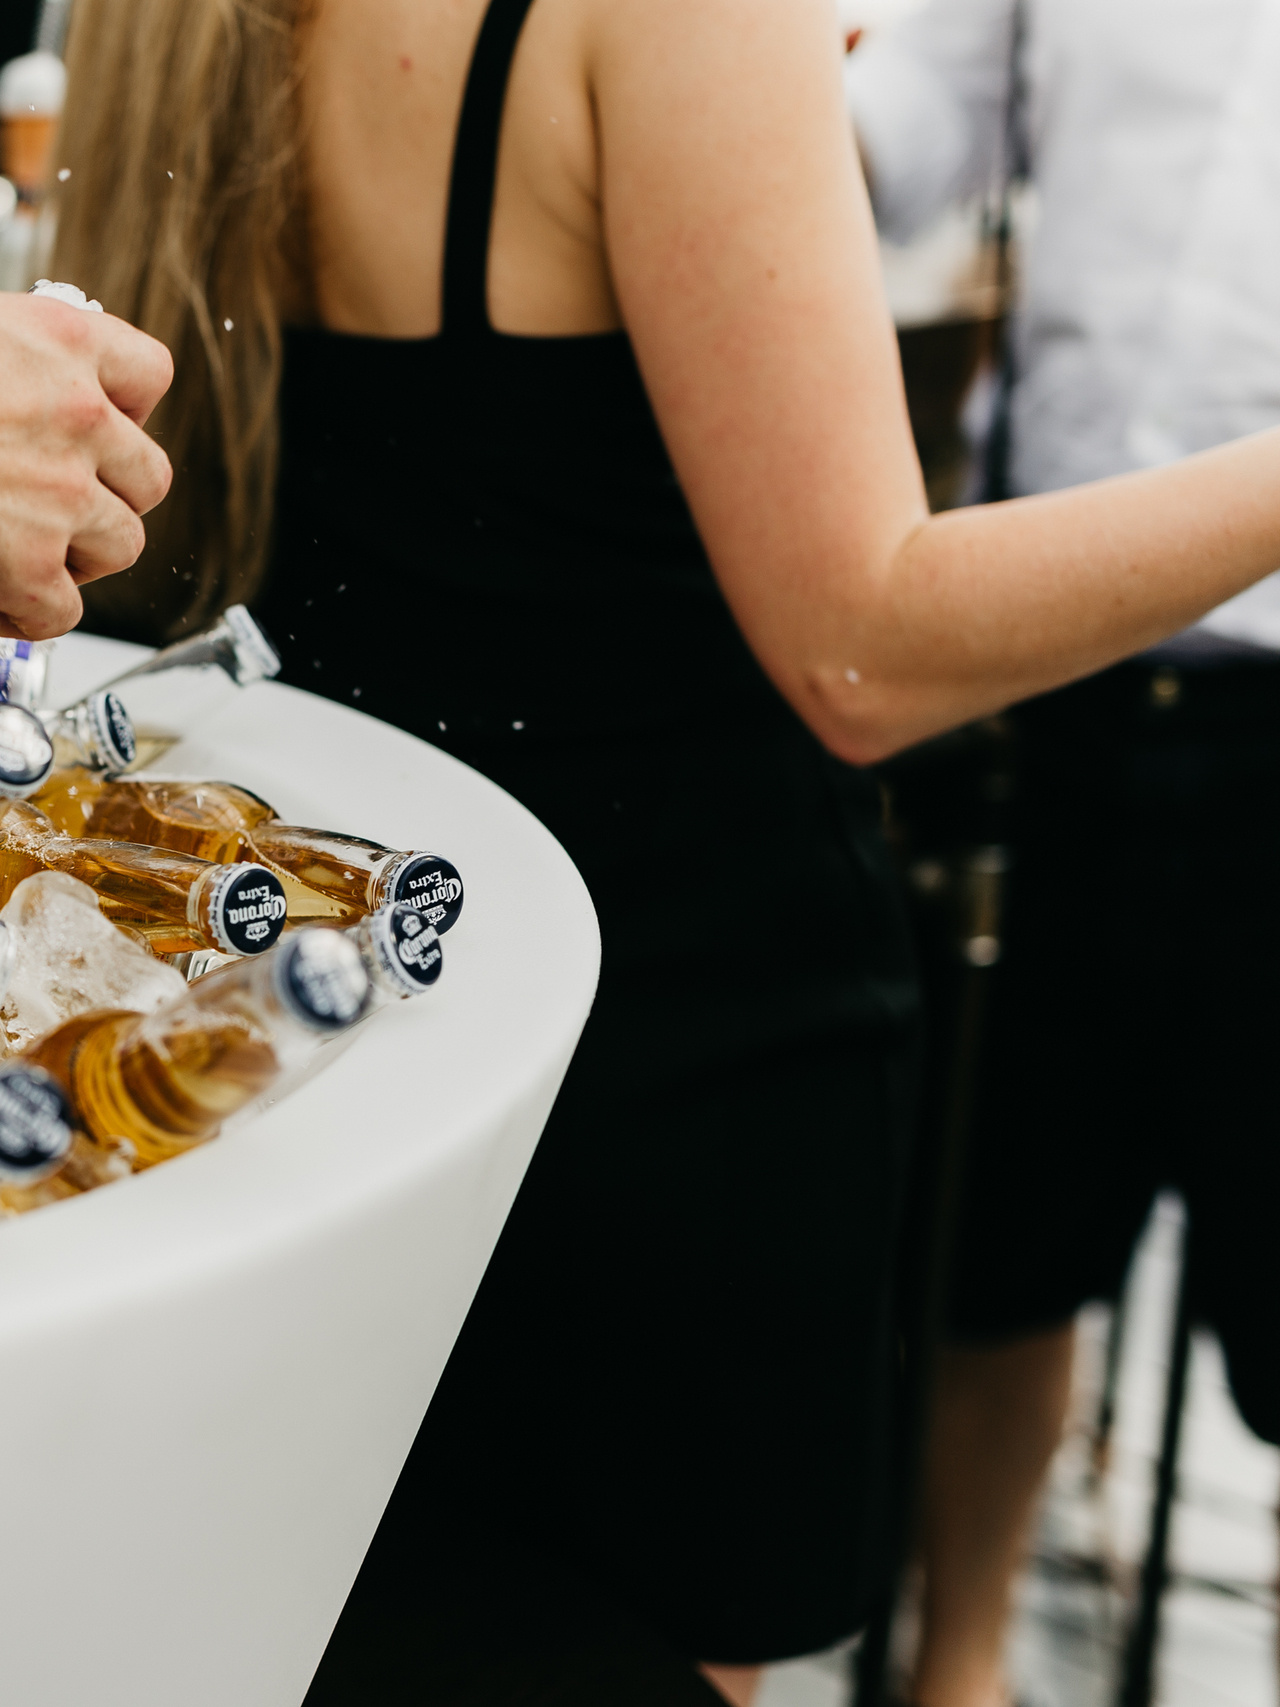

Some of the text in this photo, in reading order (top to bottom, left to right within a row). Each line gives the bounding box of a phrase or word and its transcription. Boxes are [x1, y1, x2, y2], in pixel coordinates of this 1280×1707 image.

[408, 870, 444, 890] Extra
[238, 885, 271, 902] Extra
[228, 895, 287, 925] Corona
